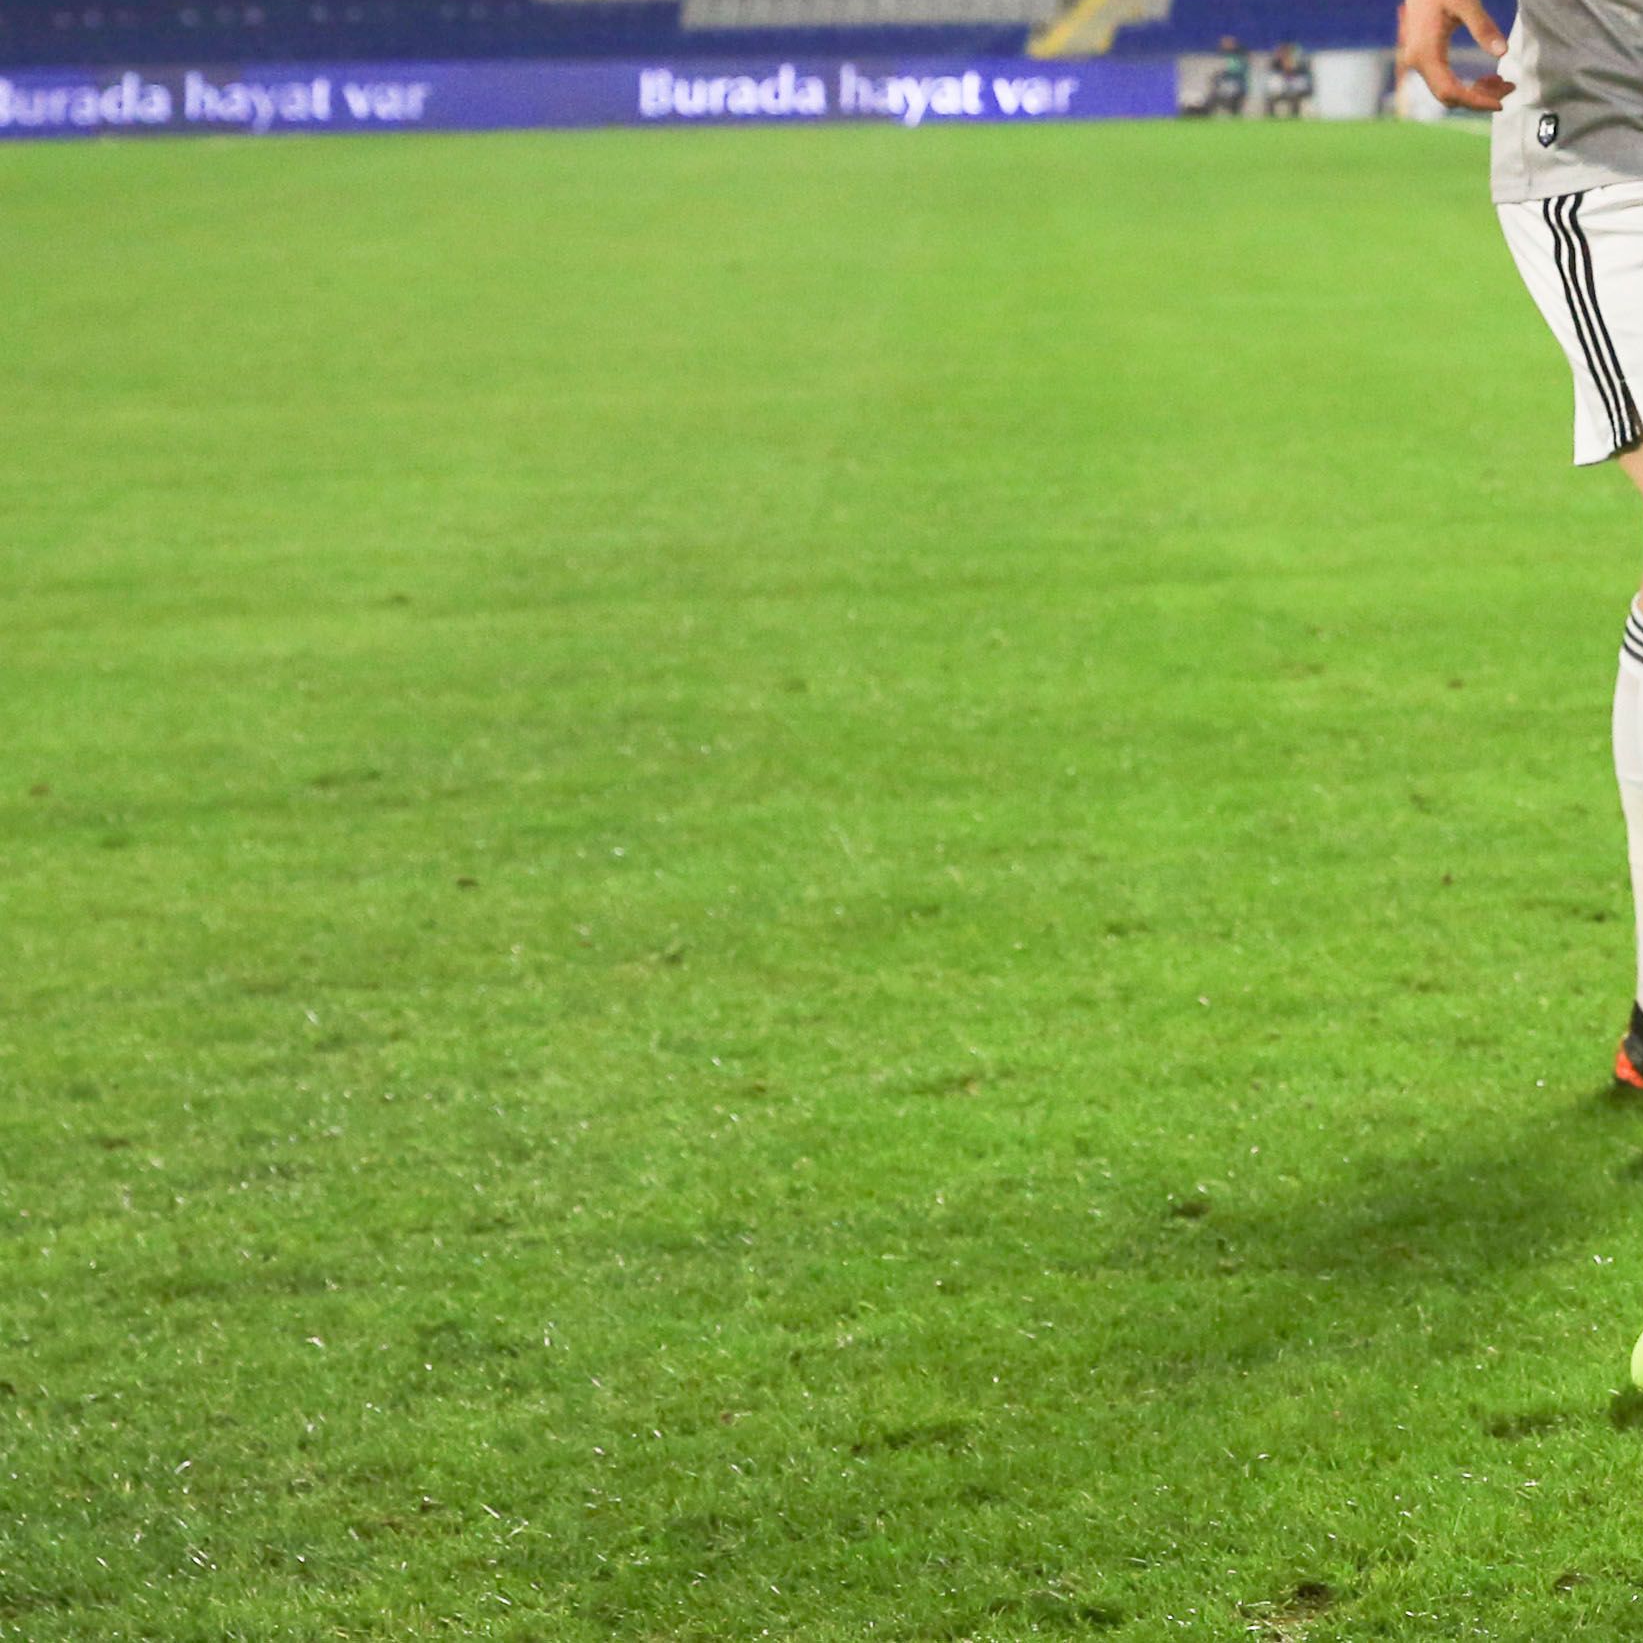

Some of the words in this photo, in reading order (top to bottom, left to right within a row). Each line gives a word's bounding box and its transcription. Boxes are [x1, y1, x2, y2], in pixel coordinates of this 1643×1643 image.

[184, 70, 332, 133] hayat
[342, 82, 429, 121] var
[639, 63, 828, 118] Burada
[838, 63, 983, 128] hayat
[992, 76, 1079, 115] var
